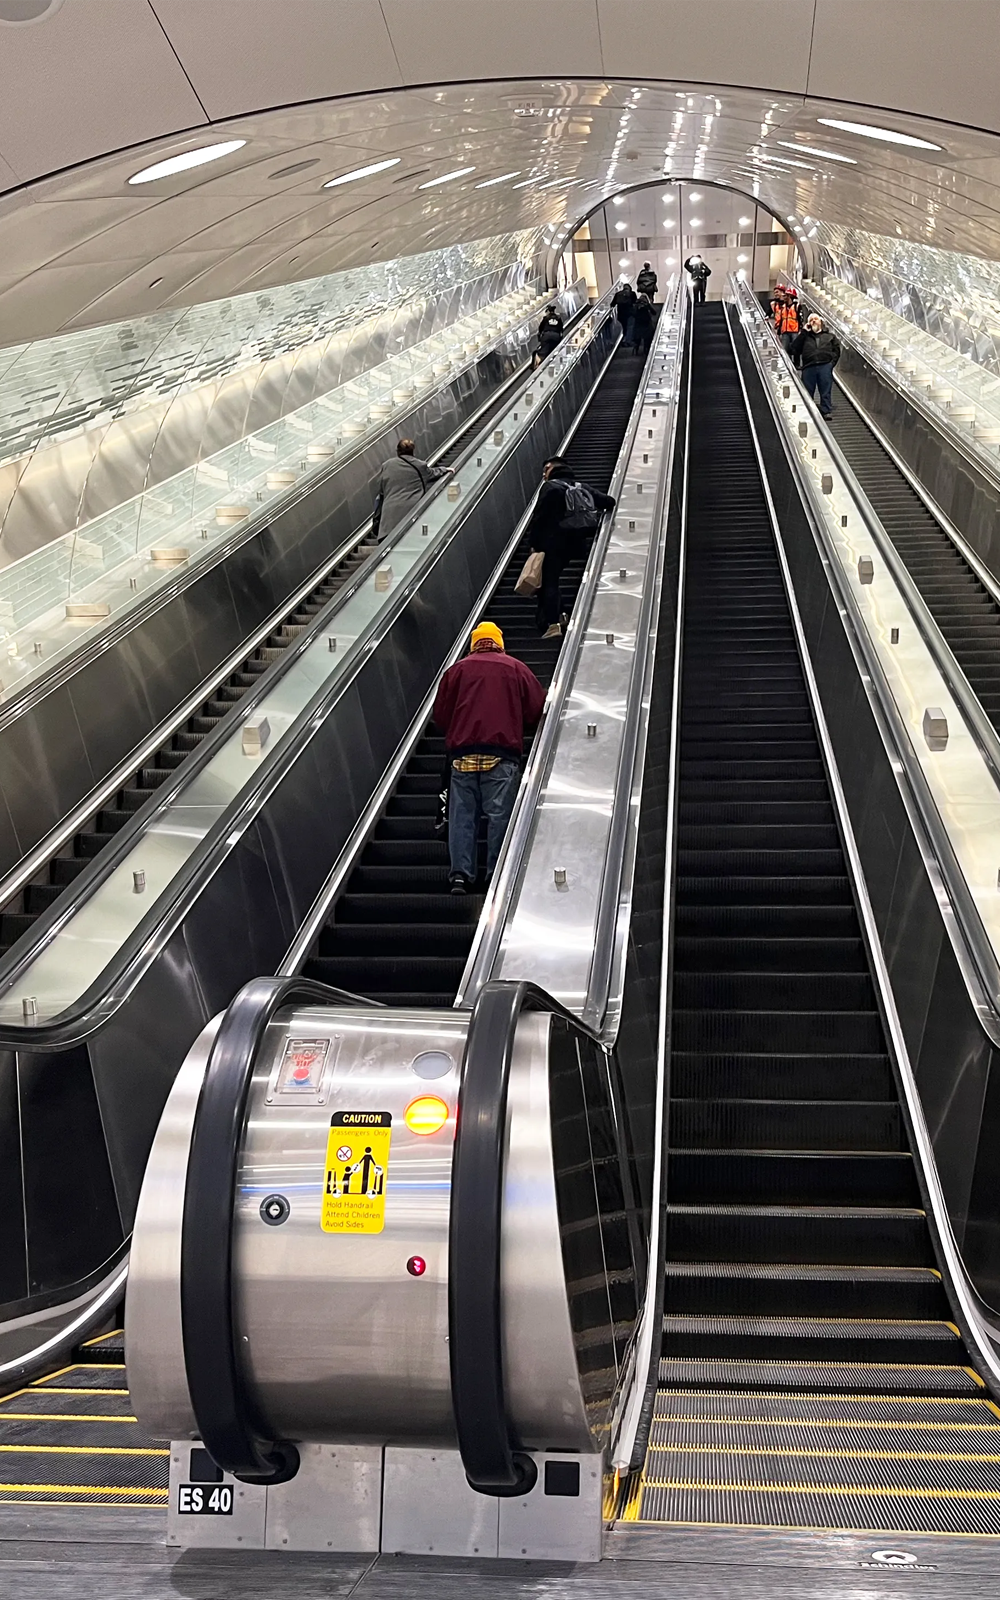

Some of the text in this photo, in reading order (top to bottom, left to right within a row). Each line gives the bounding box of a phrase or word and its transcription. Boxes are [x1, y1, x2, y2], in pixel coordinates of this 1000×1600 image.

[342, 1114, 382, 1124] CAUTION
[331, 1129, 389, 1138] Passengers Only
[351, 1211, 381, 1219] Children
[325, 1220, 365, 1229] Avoid Sides
[179, 1487, 231, 1512] ES 40
